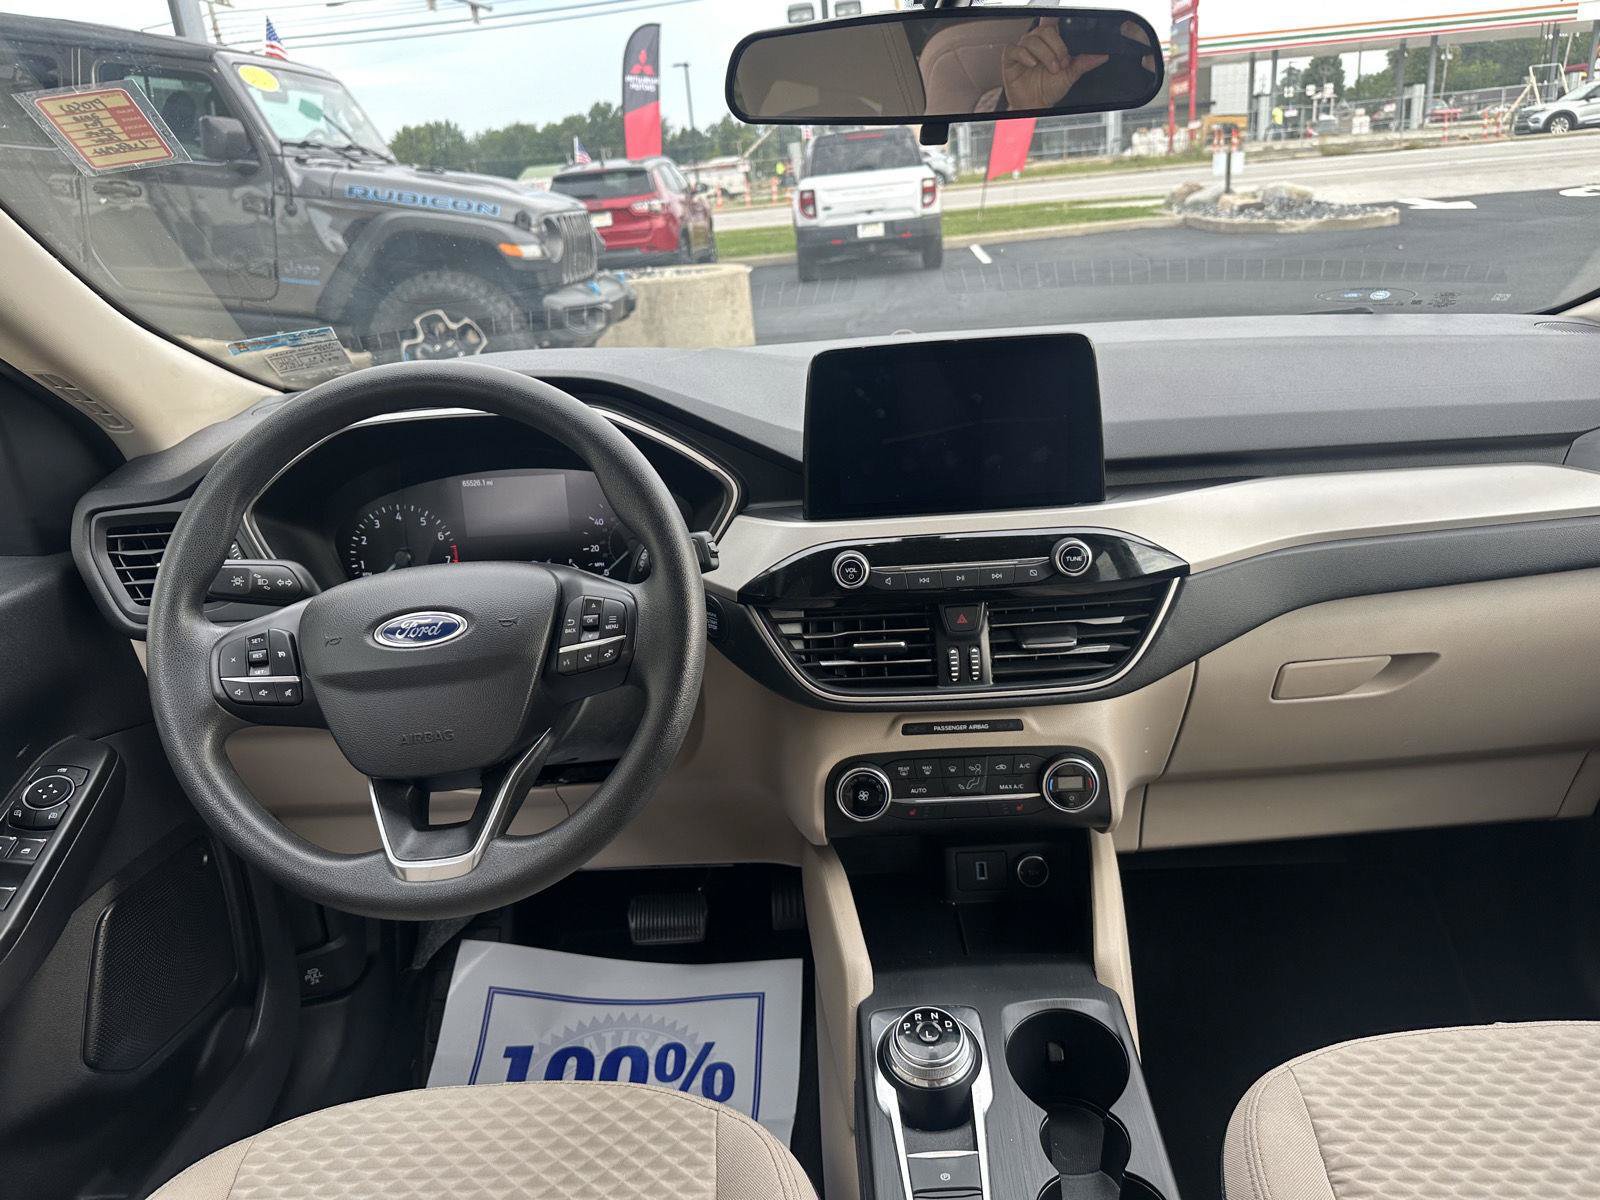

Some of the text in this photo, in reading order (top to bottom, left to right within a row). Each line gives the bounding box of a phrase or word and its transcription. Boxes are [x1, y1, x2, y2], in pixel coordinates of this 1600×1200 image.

[345, 184, 501, 217] RUBICON
[395, 512, 402, 521] 4
[374, 520, 380, 529] 3
[420, 517, 427, 526] 5
[594, 518, 604, 526] 40
[360, 536, 367, 545] 2
[437, 532, 444, 541] 6
[589, 544, 600, 553] 20
[445, 556, 451, 564] 7
[1065, 554, 1083, 563] TUNE
[360, 561, 365, 569] 1
[844, 566, 858, 574] VOL
[396, 619, 444, 639] Ford
[933, 724, 967, 732] PASSENGER
[401, 729, 455, 745] AIRBAG
[914, 1013, 922, 1021] R
[930, 1012, 939, 1020] N
[903, 1022, 911, 1031] P
[944, 1020, 953, 1028] D
[925, 1030, 933, 1039] L
[502, 1041, 735, 1102] 100%
